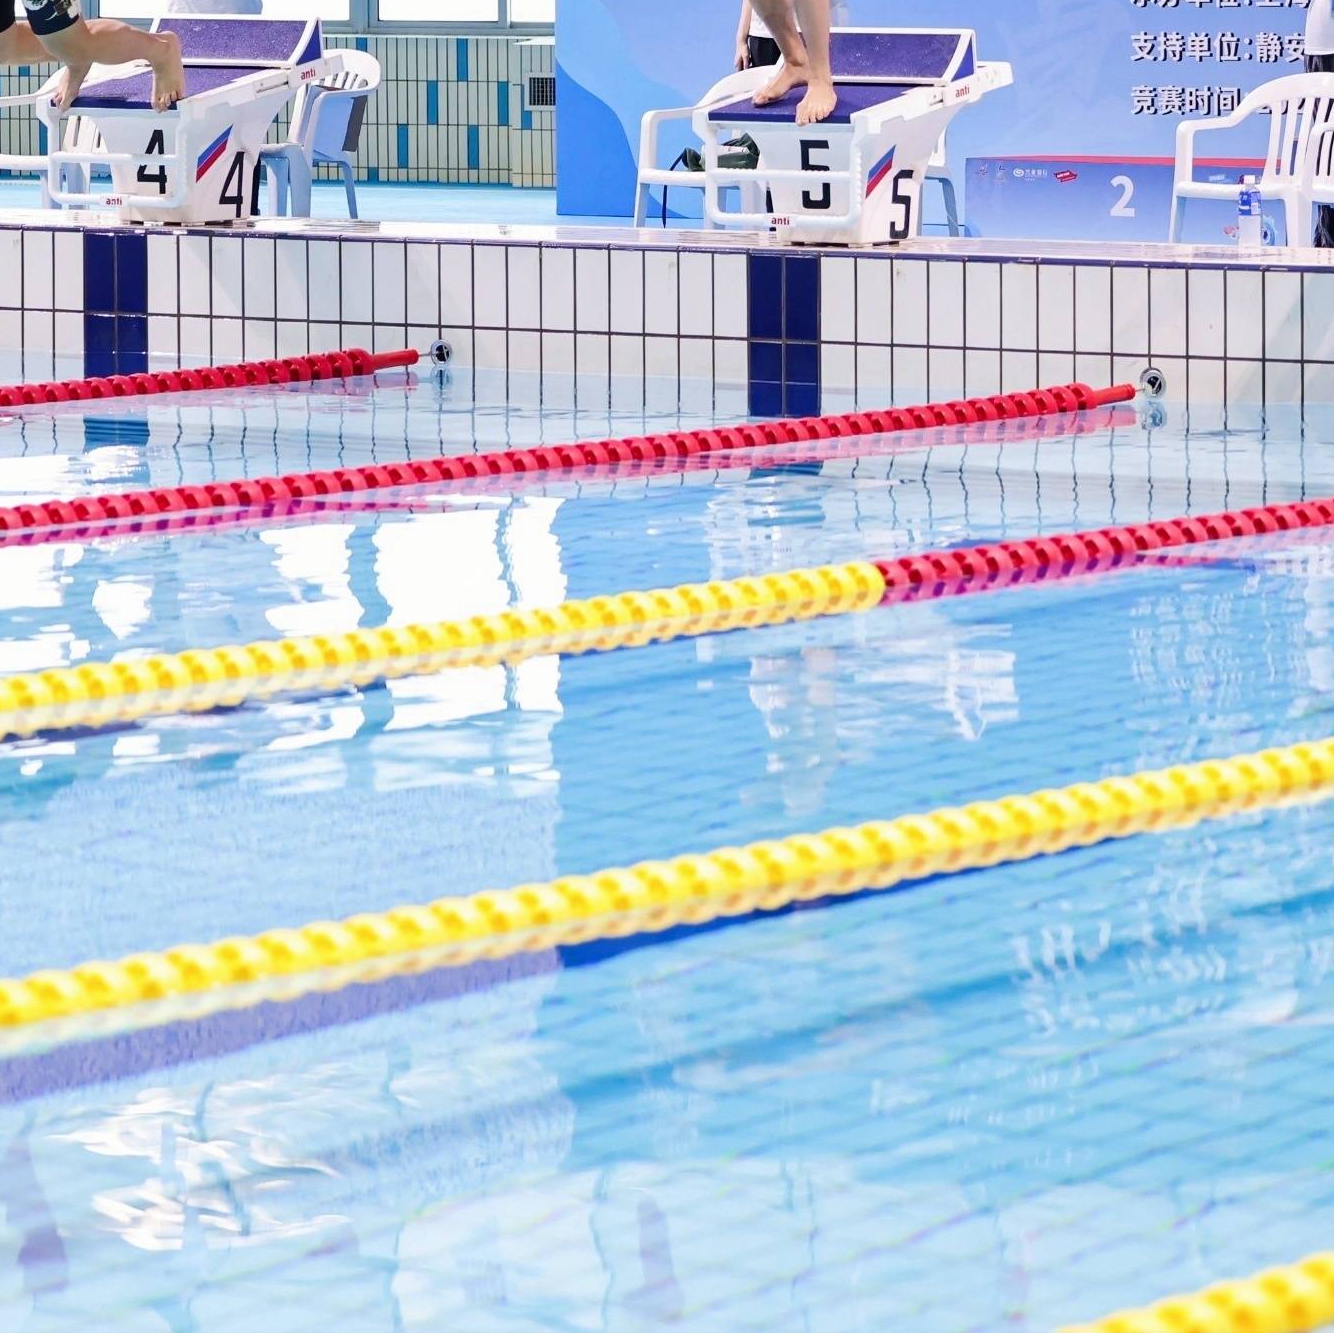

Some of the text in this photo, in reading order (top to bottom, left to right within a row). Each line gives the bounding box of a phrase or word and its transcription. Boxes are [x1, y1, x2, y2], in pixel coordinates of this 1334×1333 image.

[300, 68, 317, 81] anti
[955, 83, 972, 98] anti
[137, 129, 168, 195] 4
[800, 139, 831, 209] 5
[105, 196, 123, 206] anti
[218, 150, 245, 218] 4
[889, 169, 913, 240] 5
[1110, 175, 1136, 218] 2
[771, 215, 791, 226] anti
